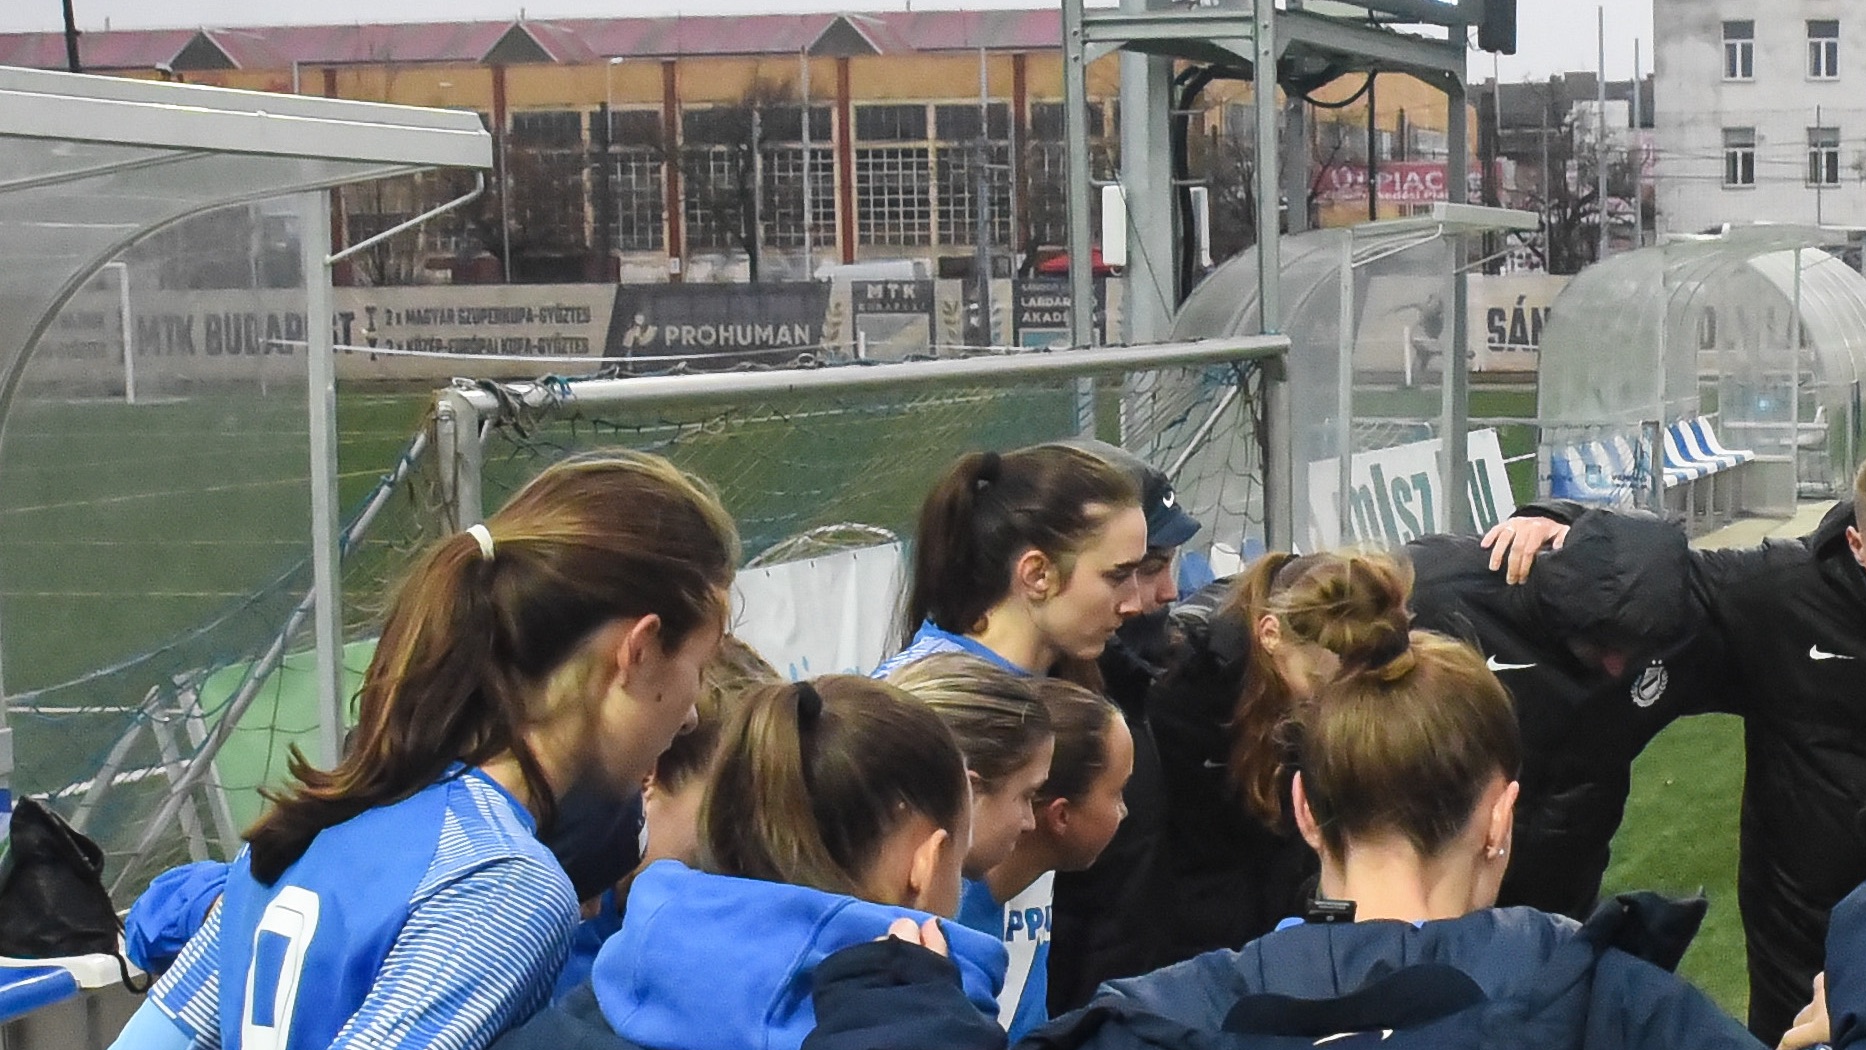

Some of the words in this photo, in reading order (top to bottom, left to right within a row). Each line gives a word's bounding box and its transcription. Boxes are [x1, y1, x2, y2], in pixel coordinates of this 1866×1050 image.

[867, 283, 915, 299] MTK
[406, 307, 454, 325] MAGYAR
[1487, 294, 1551, 352] SÁN
[134, 313, 196, 355] MTK
[205, 311, 354, 356] BUDAPT
[665, 324, 811, 347] PROHUMAN
